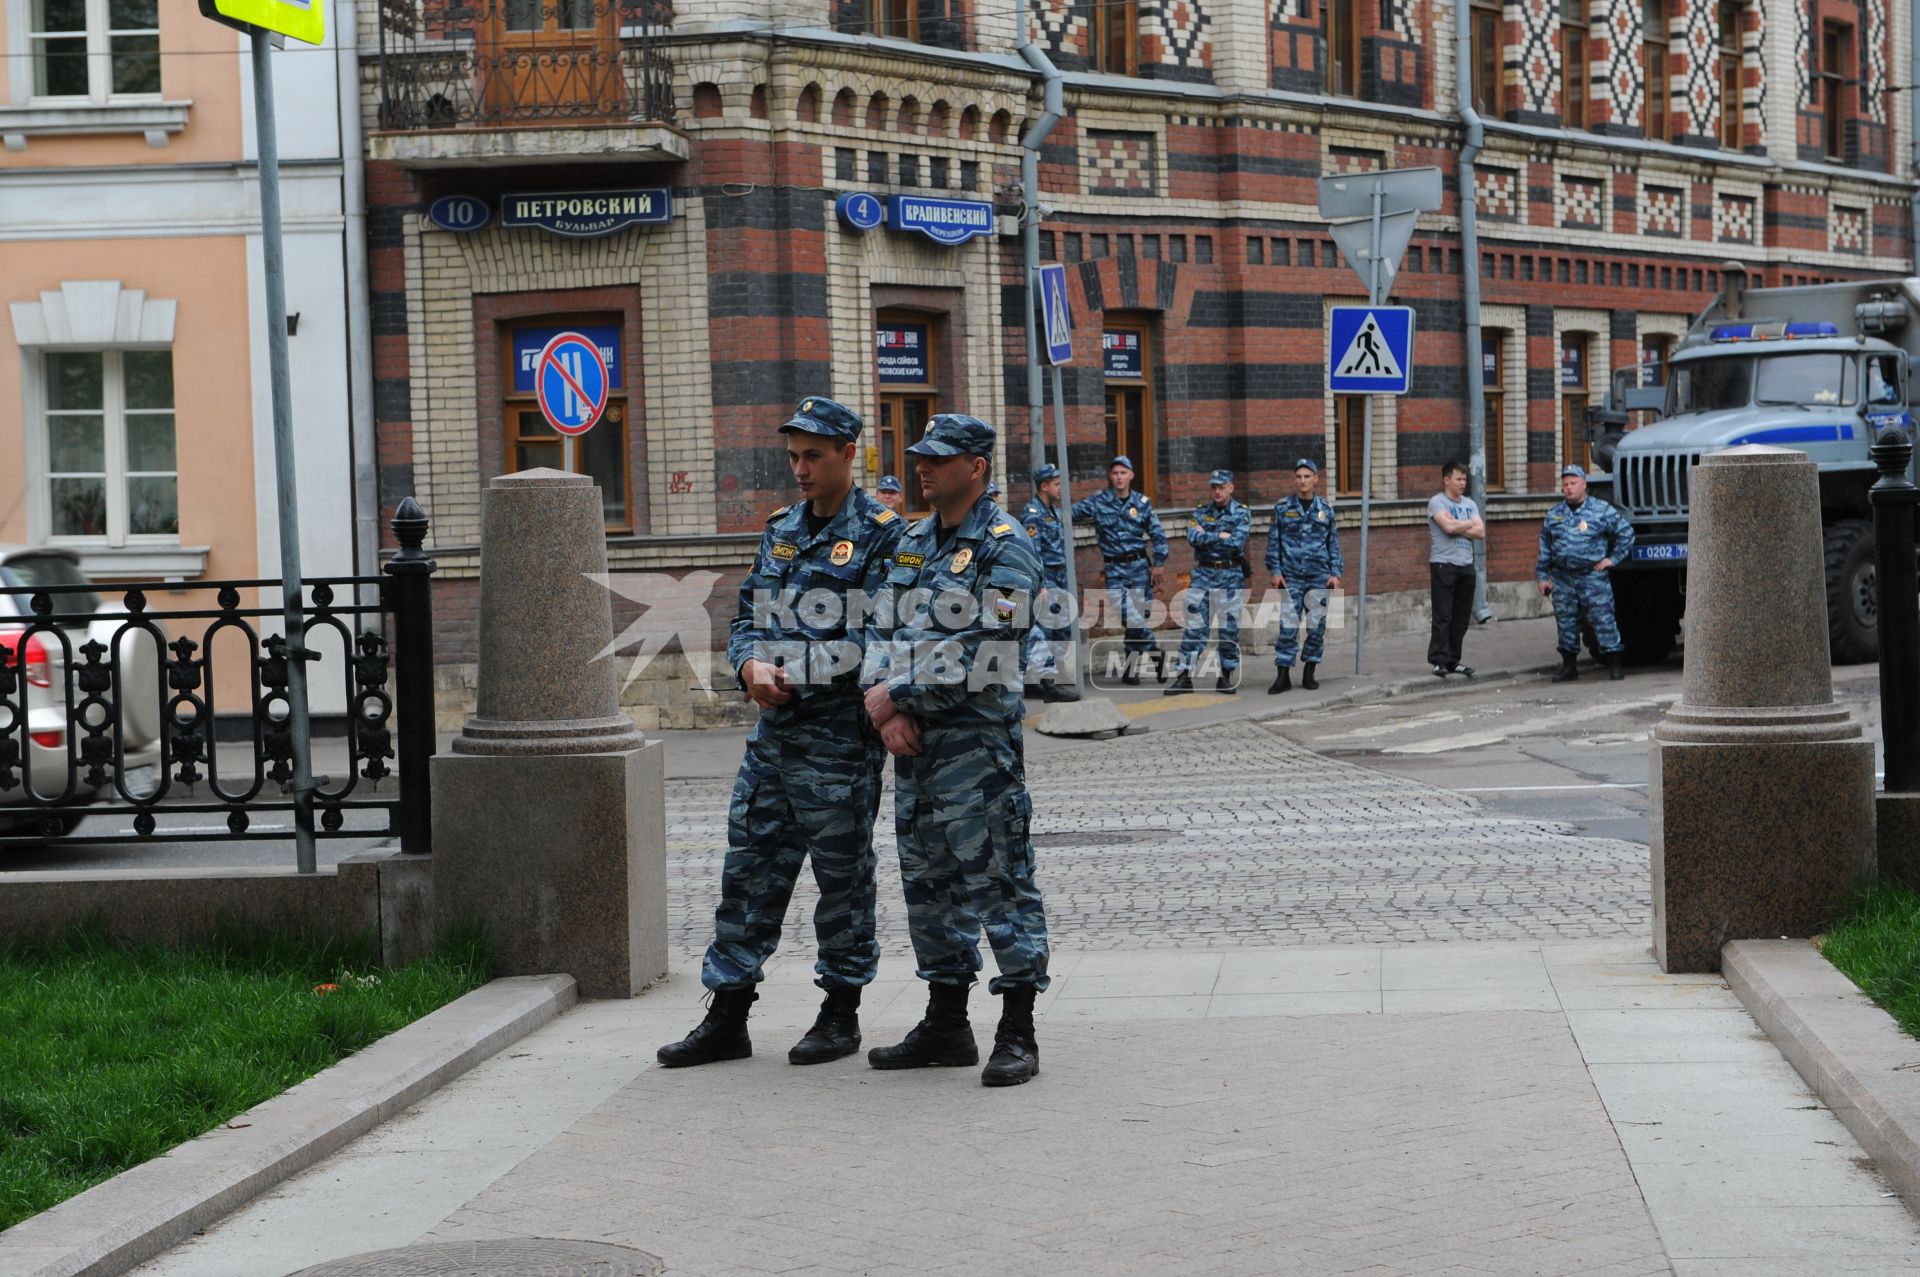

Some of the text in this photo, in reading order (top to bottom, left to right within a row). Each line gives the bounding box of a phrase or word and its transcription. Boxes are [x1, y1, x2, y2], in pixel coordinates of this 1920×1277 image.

[448, 201, 473, 225] 10
[516, 194, 652, 219] ПЕТРОВСКИЙ
[857, 198, 868, 218] 4
[905, 204, 987, 226] КРАПИВЕНСКИЙ
[555, 218, 615, 232] БУЛЬВАР
[773, 544, 794, 559] ОМОН
[899, 555, 921, 565] ОМОН
[1646, 545, 1673, 559] 0202
